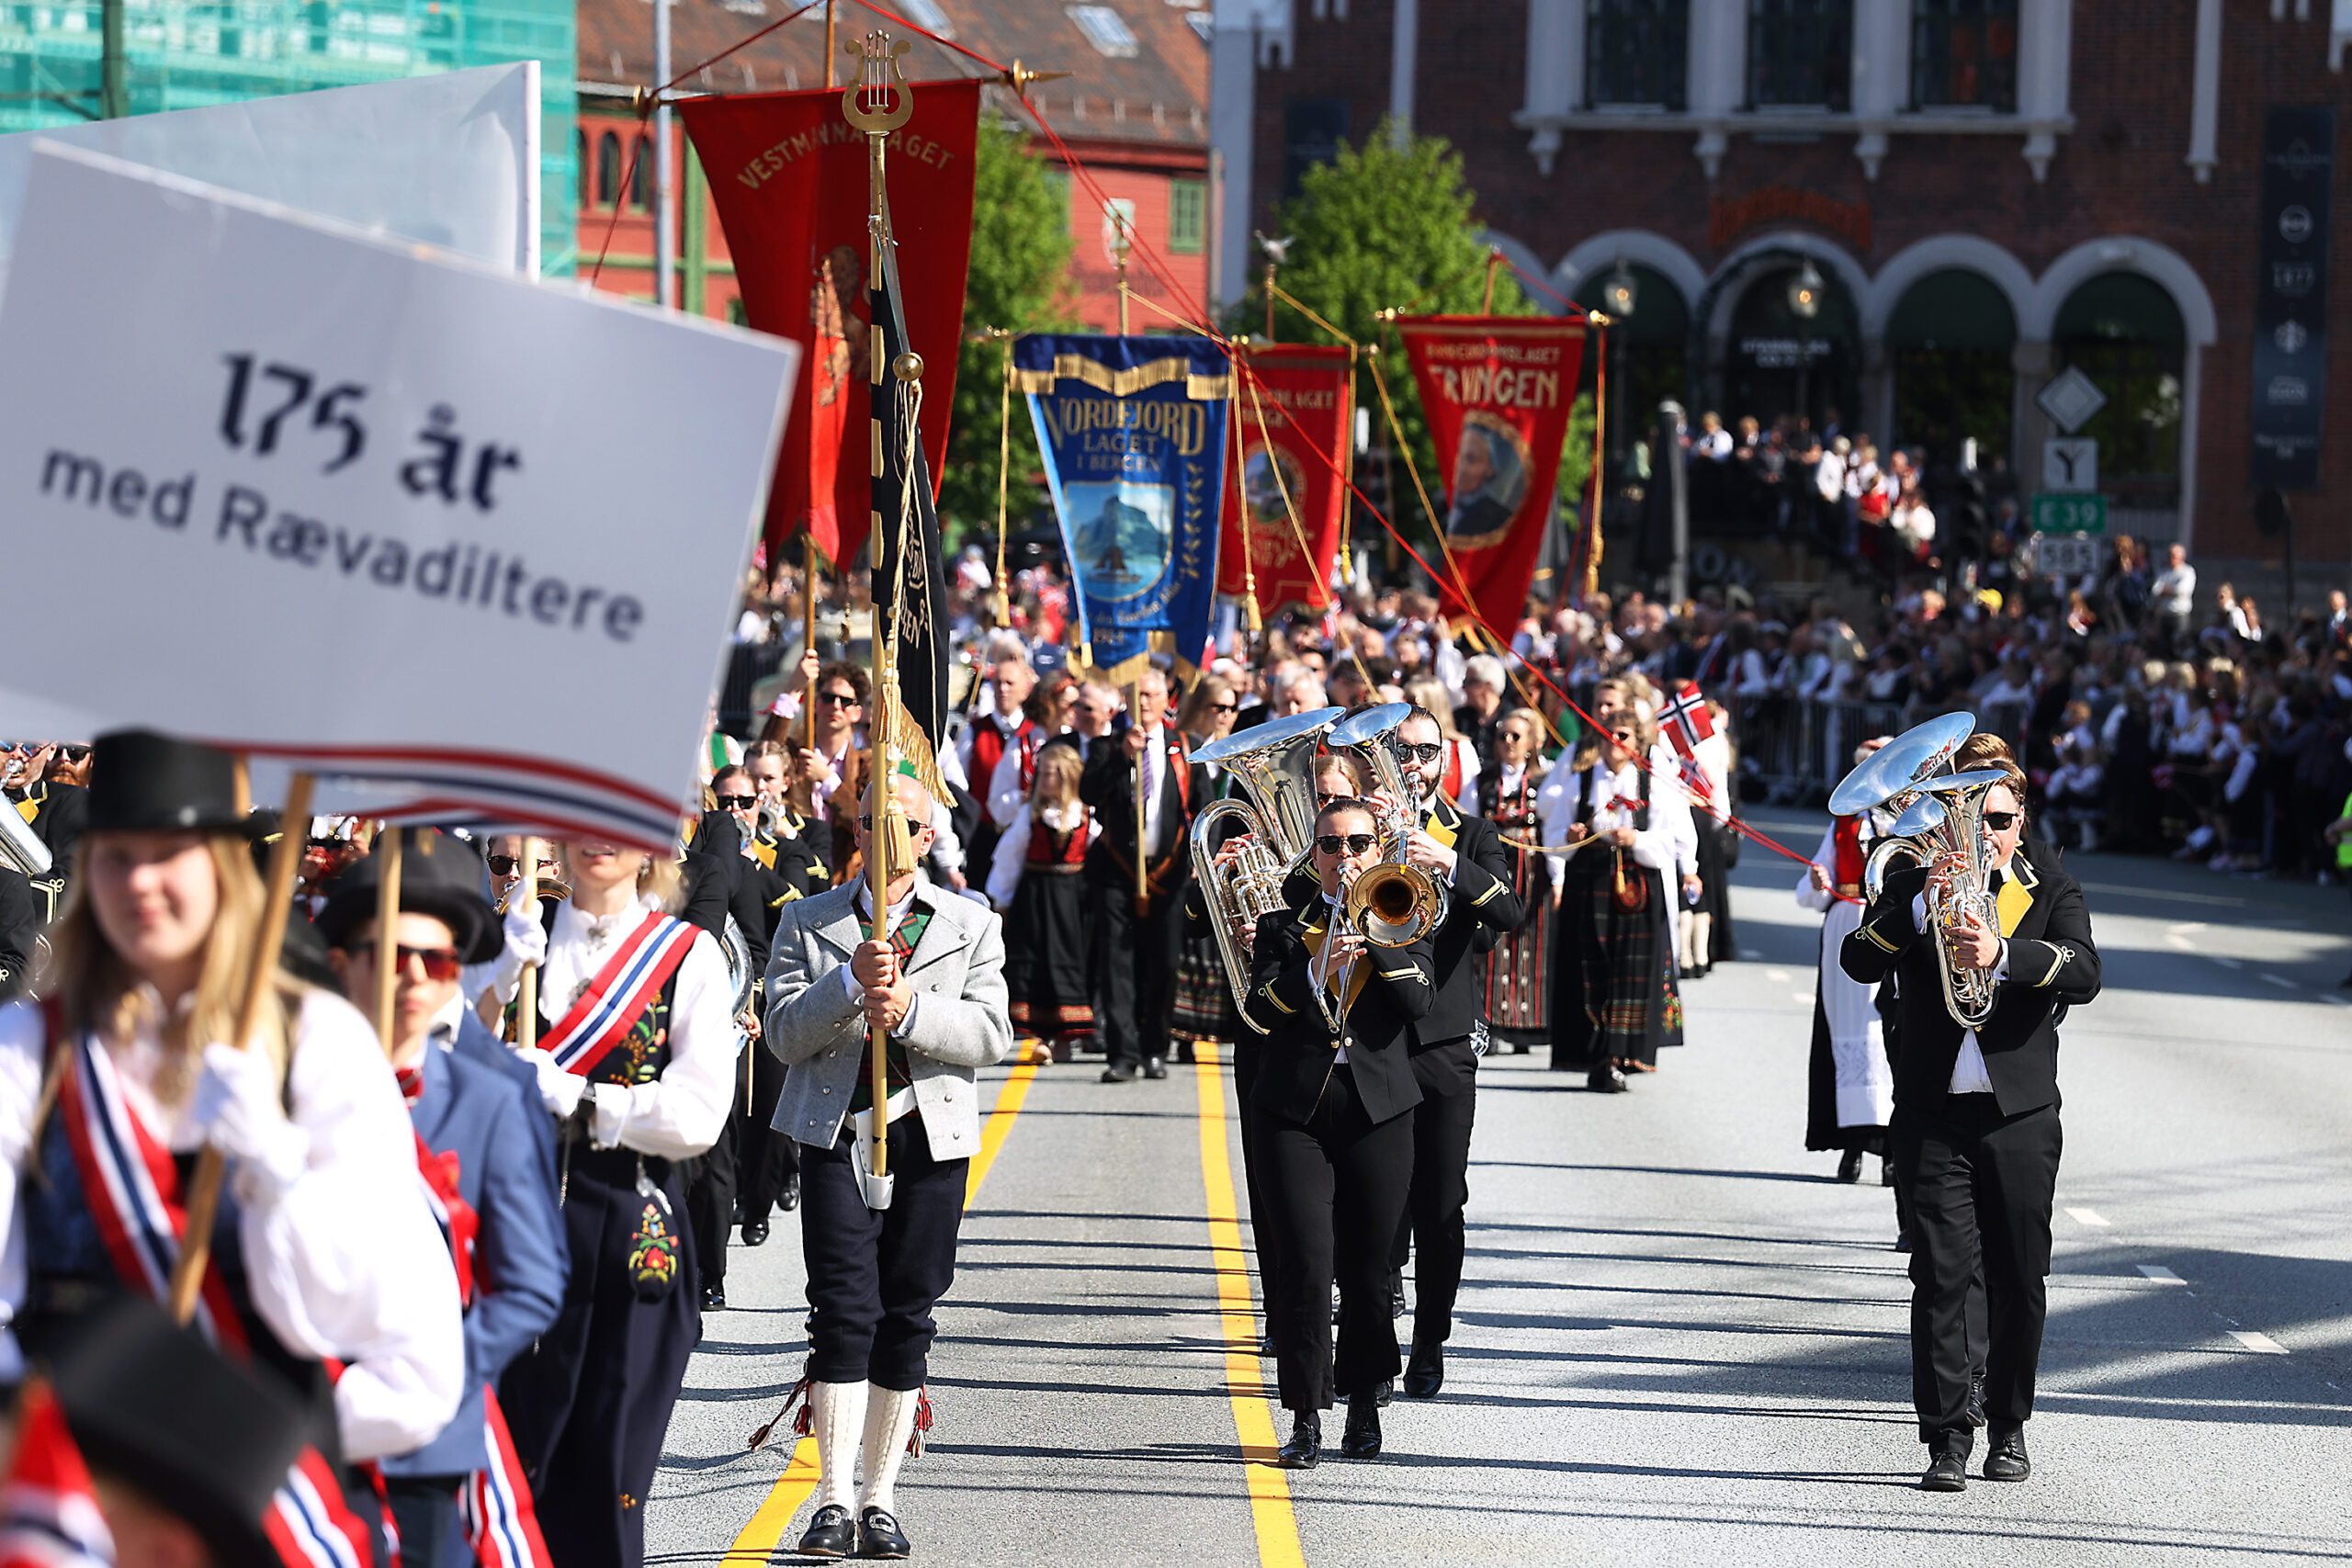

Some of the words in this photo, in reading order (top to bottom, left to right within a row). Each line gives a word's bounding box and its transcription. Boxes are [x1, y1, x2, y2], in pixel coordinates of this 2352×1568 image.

[738, 120, 956, 189] VESTMANNAAGET
[220, 352, 370, 476] 175
[396, 402, 523, 514] år
[1042, 398, 1205, 457] NORDFJORD
[1084, 433, 1159, 454] LAGET
[1090, 454, 1161, 472] BERGEN
[2039, 501, 2057, 527] E
[2063, 501, 2098, 527] 39
[40, 447, 197, 533] med
[215, 484, 645, 644] Rævadiltere
